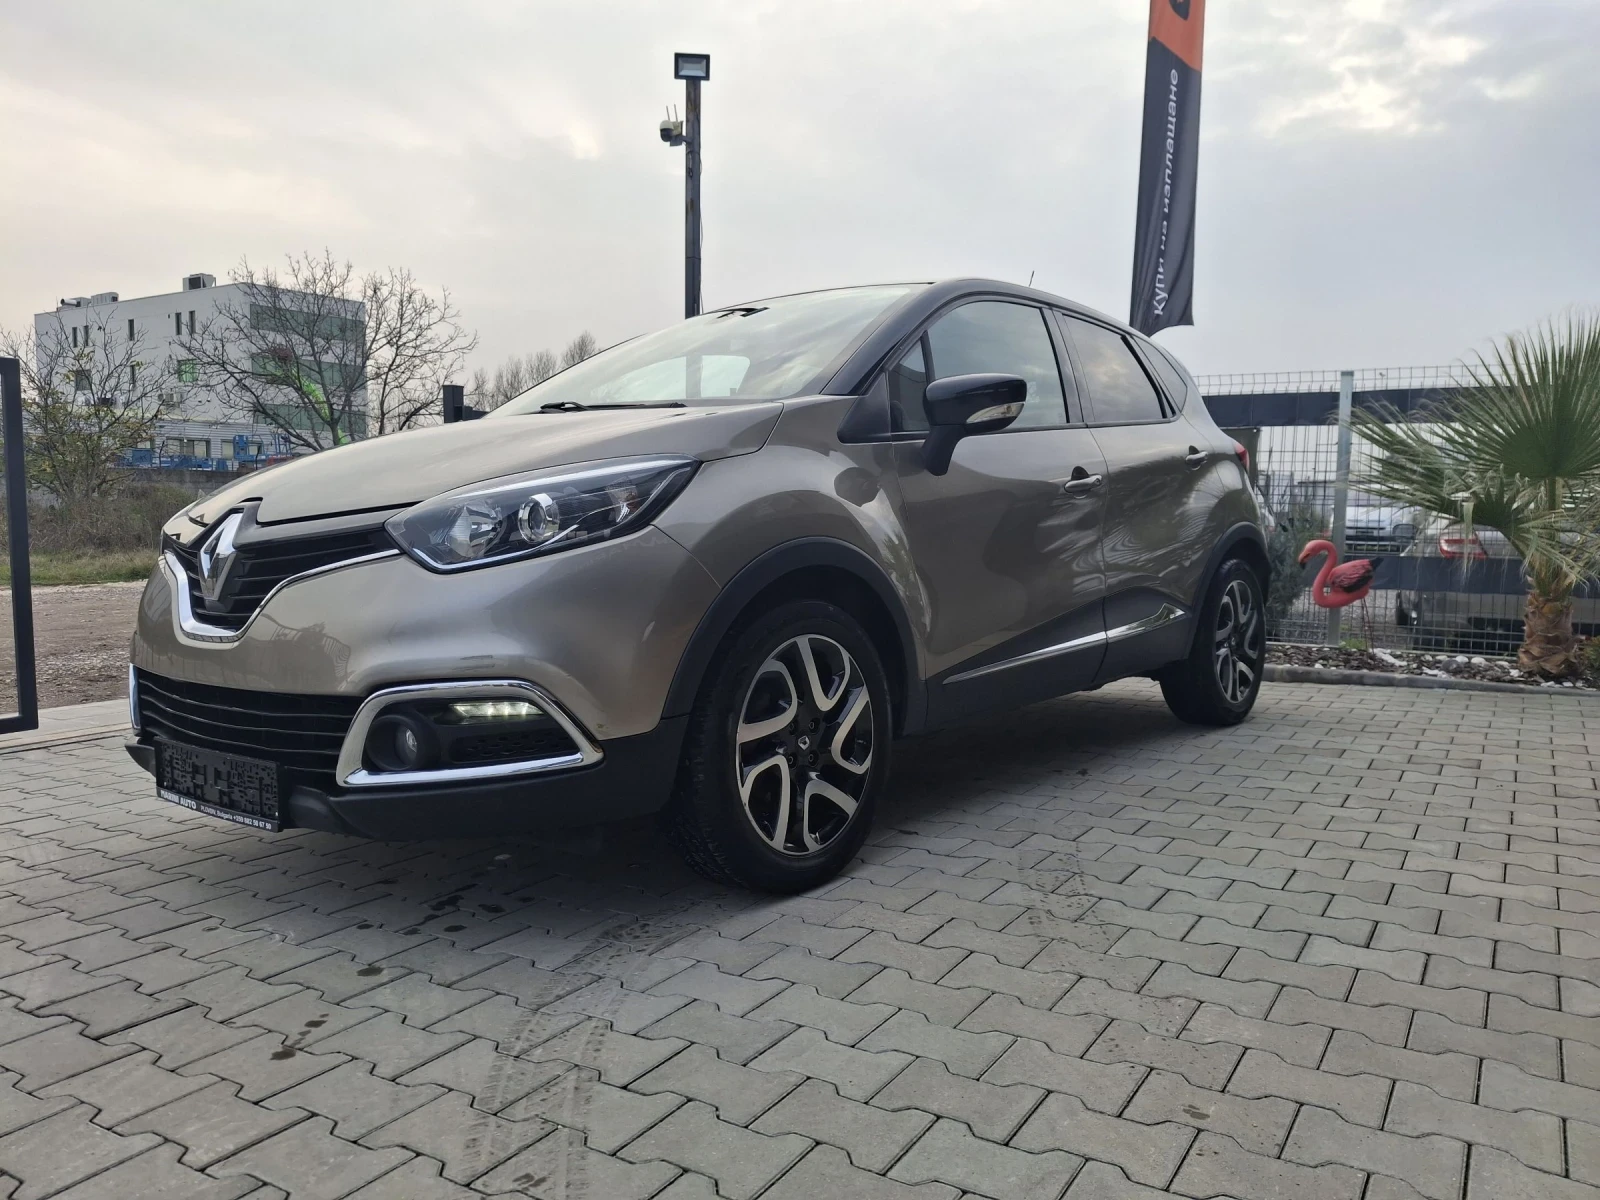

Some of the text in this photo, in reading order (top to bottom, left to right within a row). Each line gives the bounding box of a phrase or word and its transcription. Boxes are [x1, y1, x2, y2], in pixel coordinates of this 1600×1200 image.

[1153, 69, 1179, 315] Купи на изплащане
[180, 797, 197, 809] AUTO
